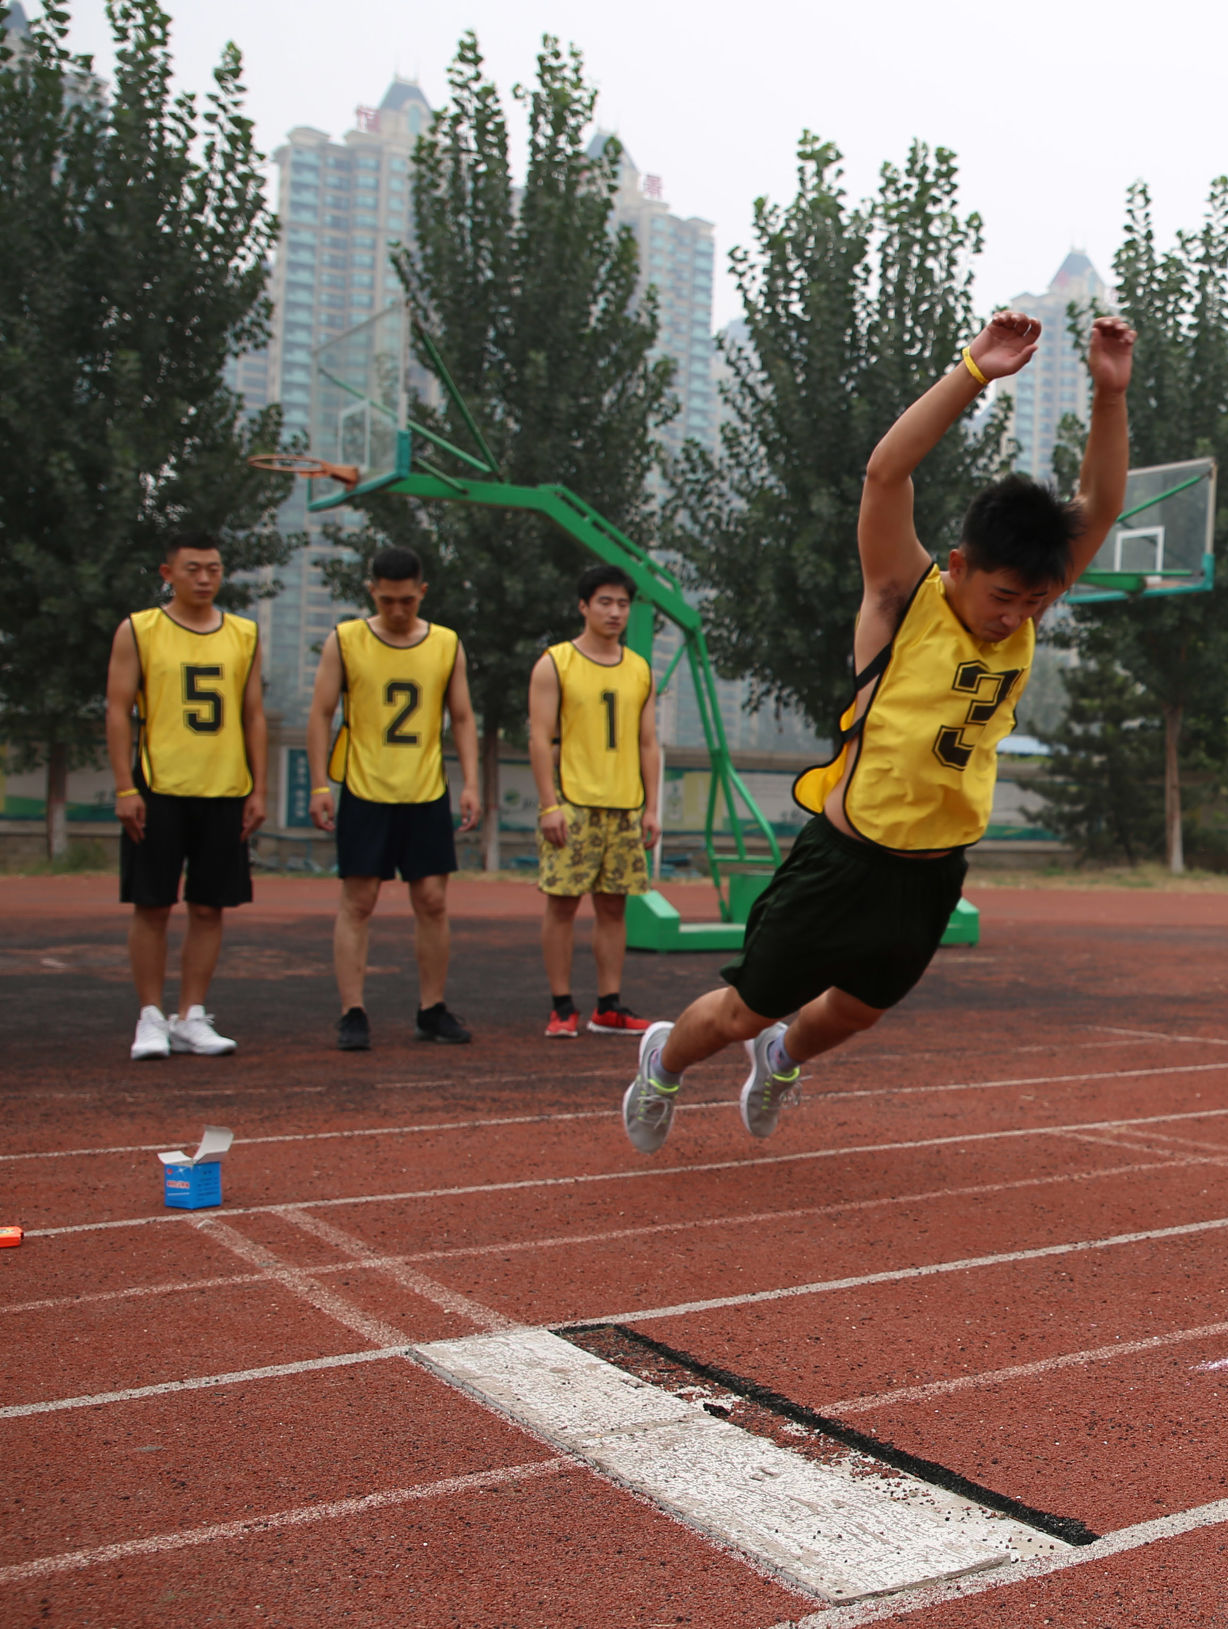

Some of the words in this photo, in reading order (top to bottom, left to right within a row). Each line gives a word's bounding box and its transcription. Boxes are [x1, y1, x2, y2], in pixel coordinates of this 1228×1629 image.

[181, 663, 224, 735] 5
[383, 679, 423, 747] 2
[600, 689, 618, 751] 1
[932, 659, 1024, 772] 3
